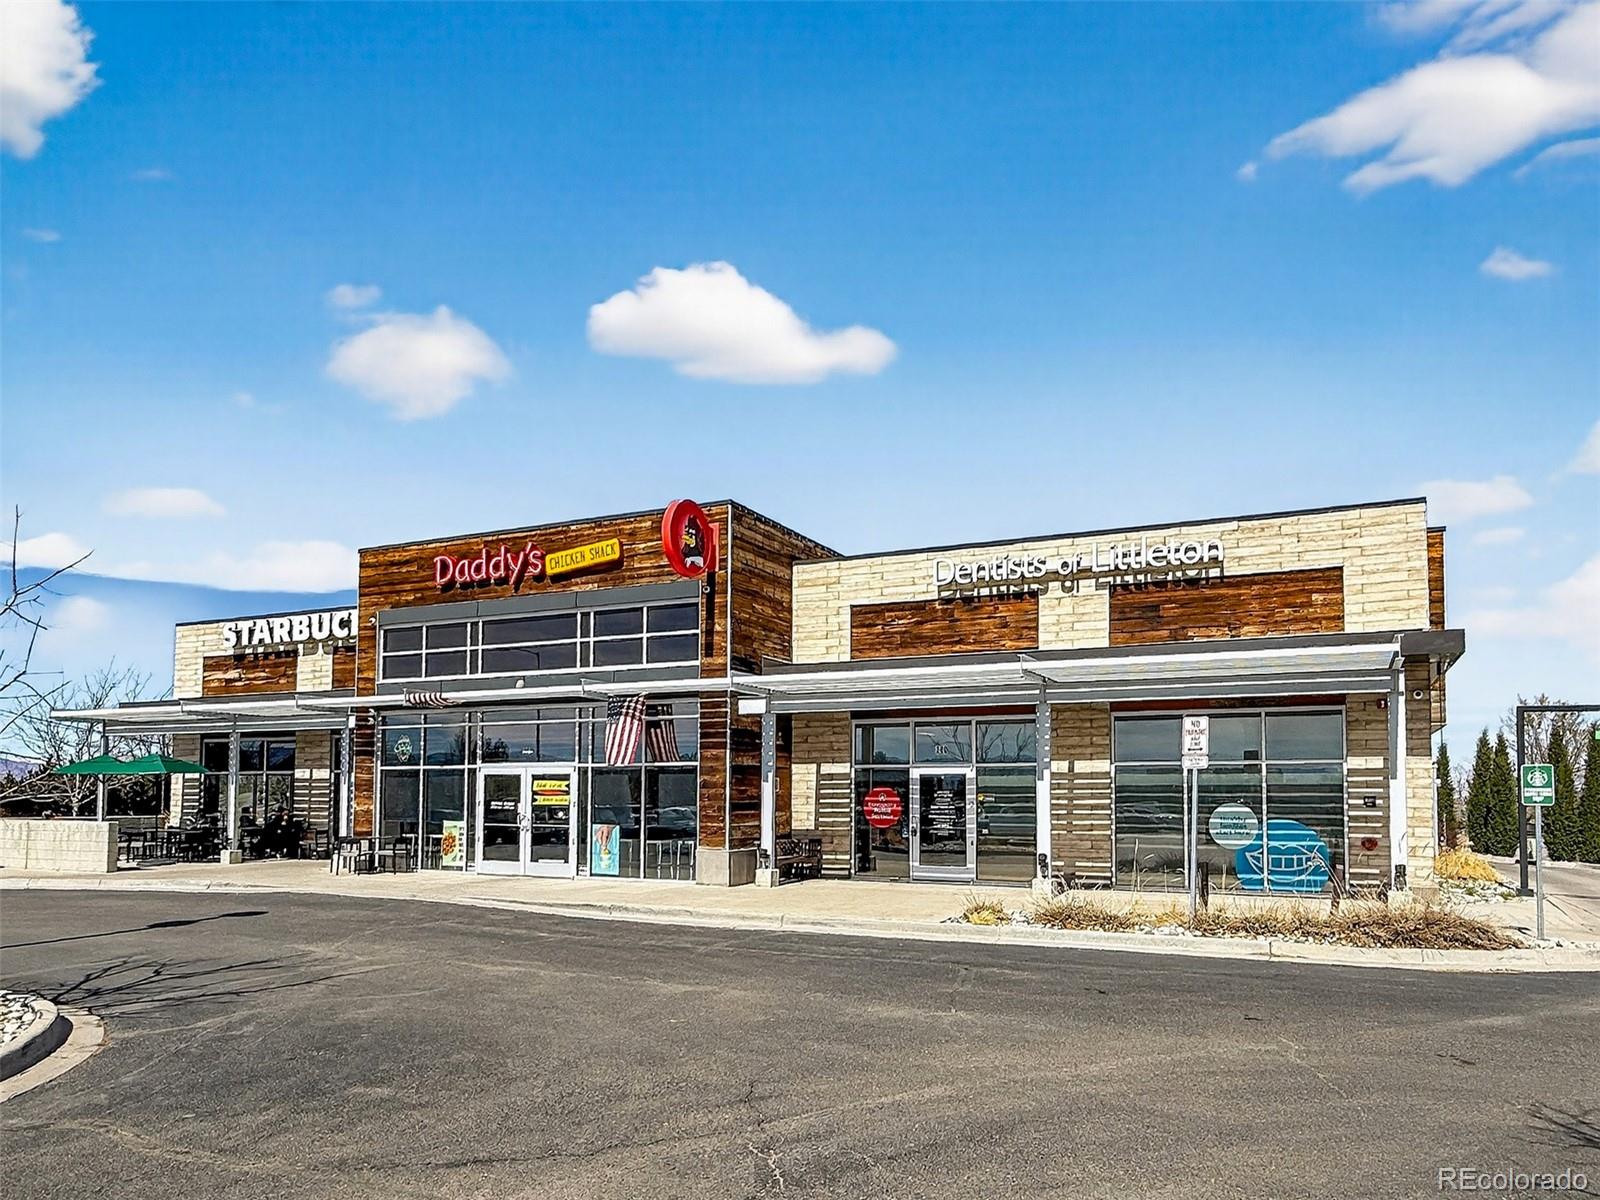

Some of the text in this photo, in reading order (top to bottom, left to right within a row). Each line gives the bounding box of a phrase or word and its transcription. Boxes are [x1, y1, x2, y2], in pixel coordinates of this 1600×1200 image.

[433, 541, 545, 587] Daddy's
[549, 543, 617, 570] CHICKEN SHACK
[931, 536, 1224, 586] Dentists of Littleton
